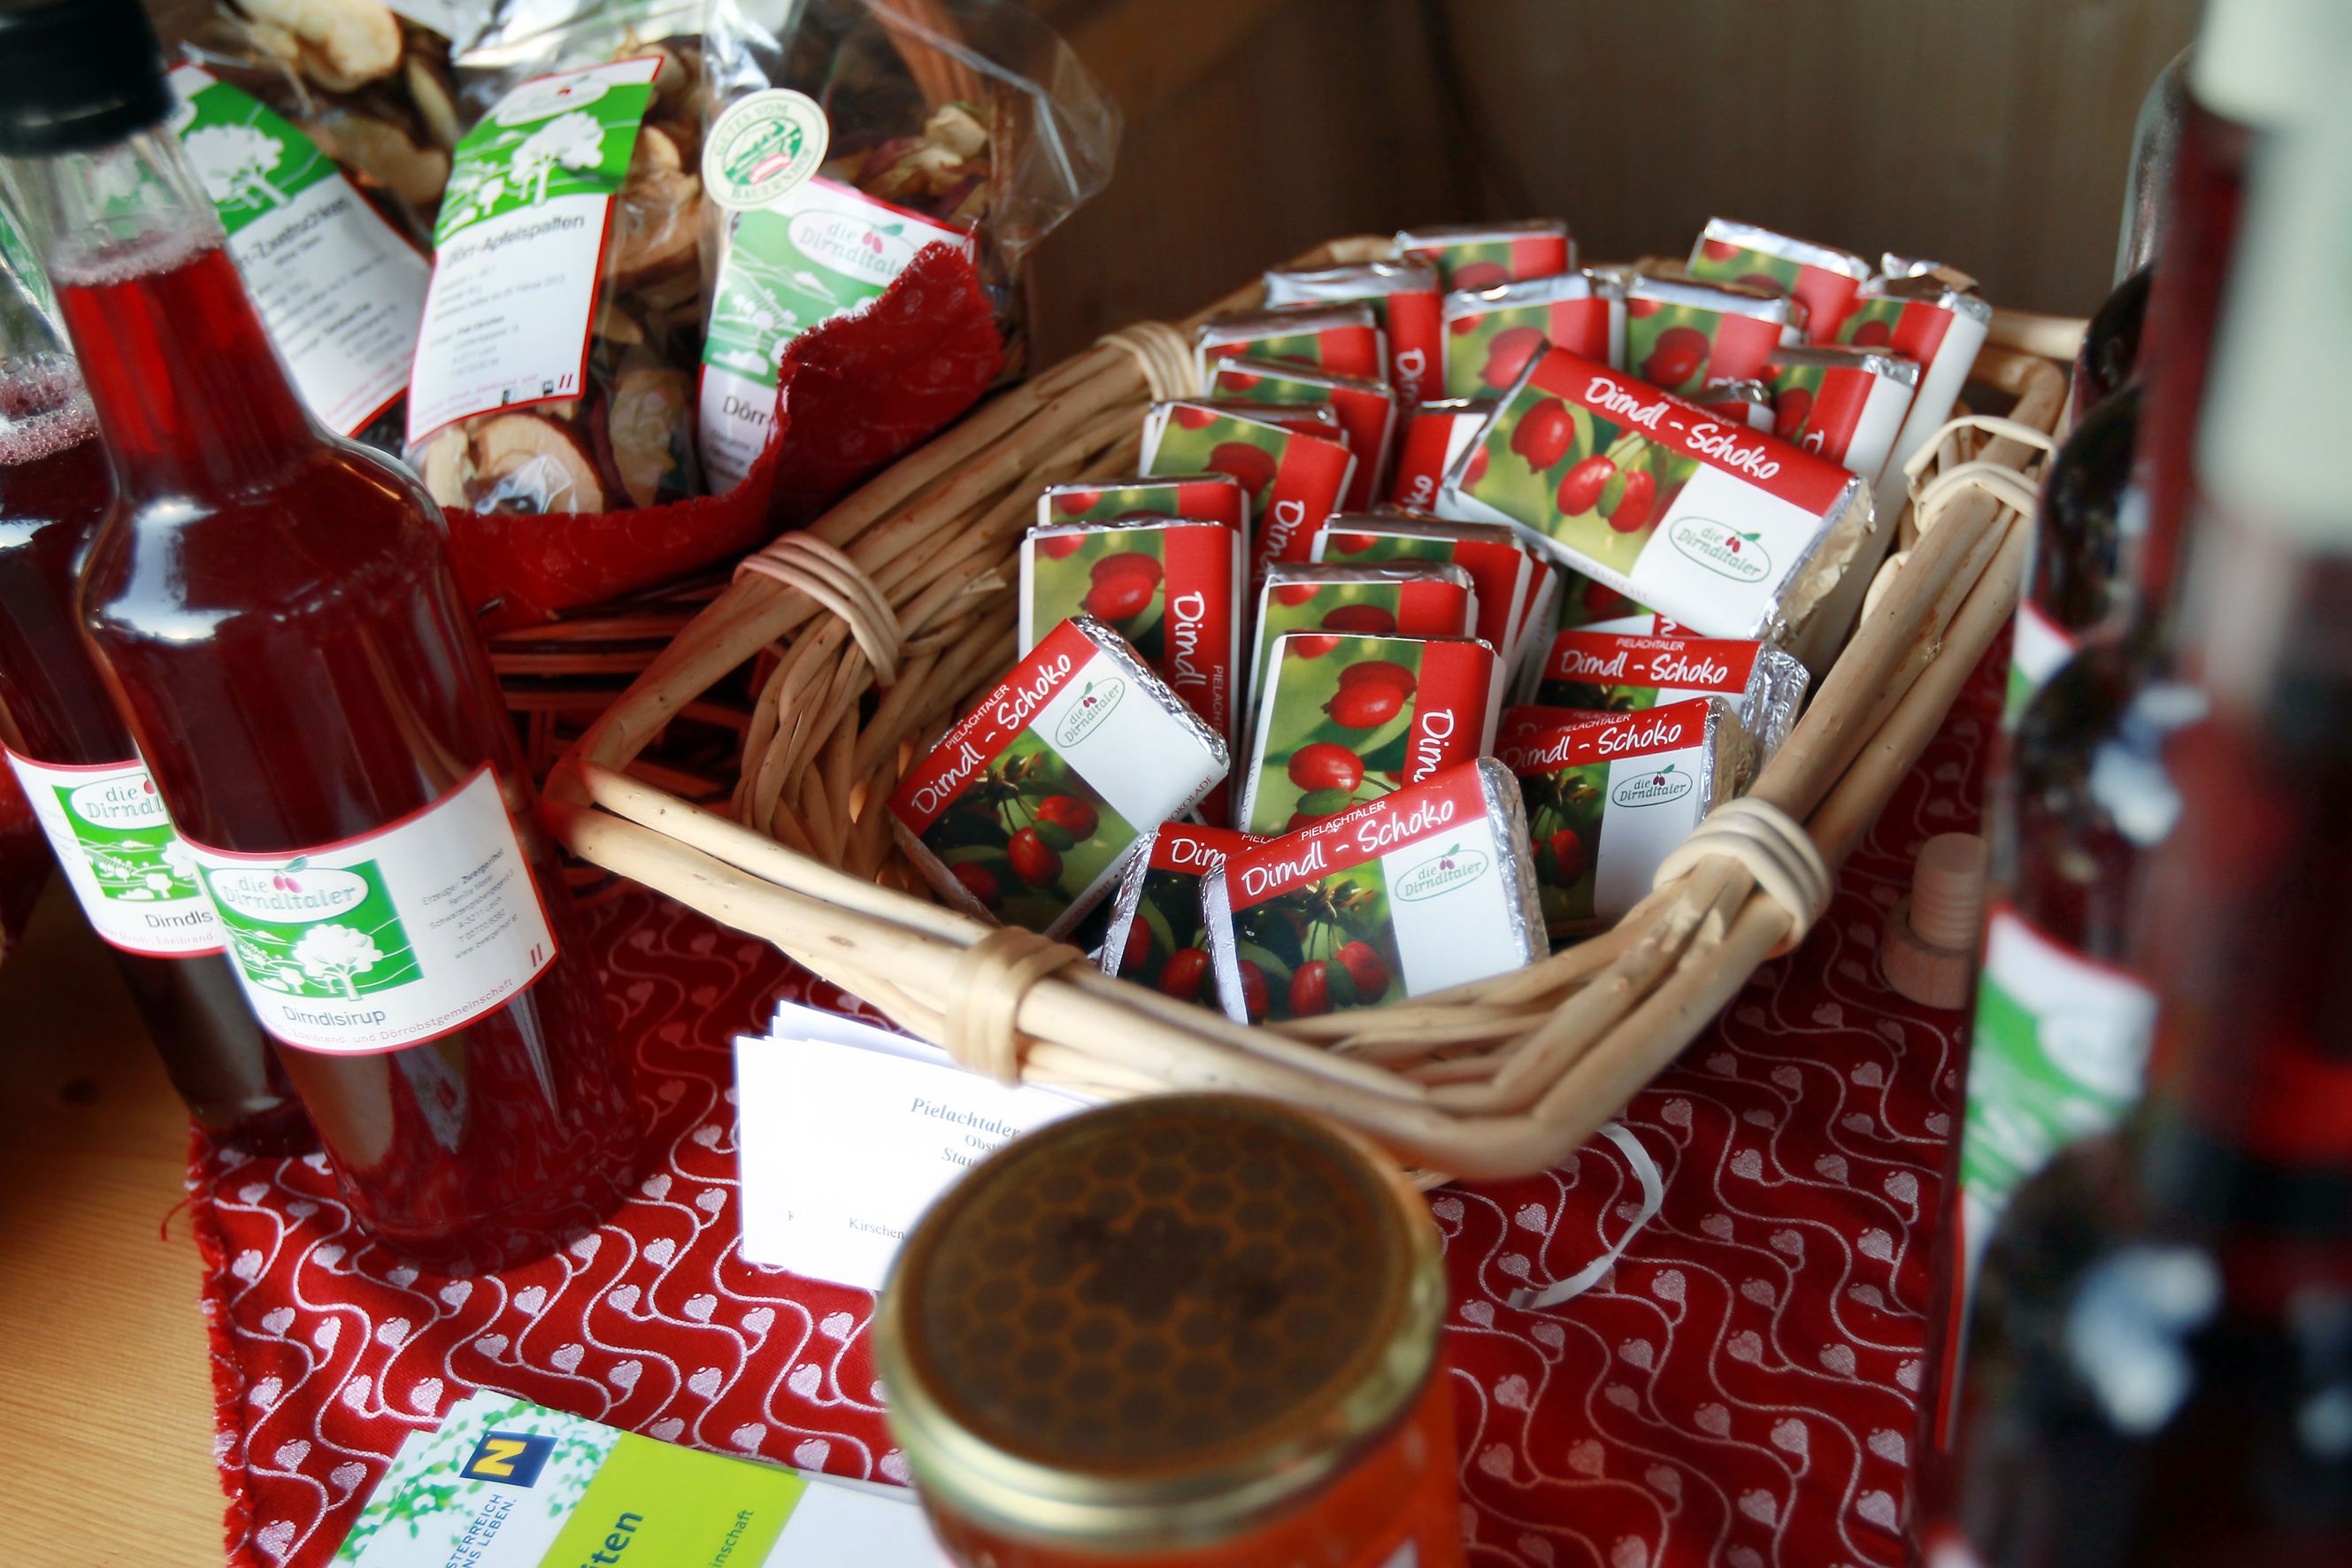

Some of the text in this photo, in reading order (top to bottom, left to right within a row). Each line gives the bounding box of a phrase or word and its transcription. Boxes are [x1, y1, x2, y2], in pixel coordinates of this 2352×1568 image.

[826, 222, 857, 240] die
[799, 225, 902, 278] Dirndltal
[1584, 376, 1671, 431] Dirndl
[1686, 422, 1780, 480] Schoko
[1677, 528, 1762, 576] Dirndltaler
[1700, 527, 1724, 543] die
[1173, 590, 1207, 689] Dirndl
[1615, 637, 1686, 652] PIELACHTALER
[1560, 650, 1628, 679] Dirndl
[1649, 653, 1728, 685] Schoko
[944, 684, 1011, 750] PIELACHTALER
[1064, 684, 1120, 743] Dirndltaler
[1069, 707, 1085, 725] die
[1556, 712, 1632, 734] PIELACHTALER
[911, 741, 986, 814] Dirndl
[997, 653, 1072, 731] Schoko
[1504, 735, 1572, 771] Dirndl
[1597, 719, 1682, 755] Schoko
[105, 787, 138, 802] die
[1618, 782, 1687, 802] Dirndltaler
[1633, 778, 1651, 791] die
[85, 796, 166, 819] Dirndl
[1301, 799, 1387, 842] PIELACHTALER
[1171, 838, 1227, 868] Dirn
[1241, 840, 1327, 897] Dirndl
[1357, 799, 1455, 854] Schoko
[238, 876, 270, 894] die
[1404, 861, 1482, 897] Dirndltaler
[1418, 865, 1437, 880] die
[222, 886, 357, 911] Dirndltaler
[145, 911, 215, 929] Dirndls
[282, 1004, 387, 1027] Dirndlsirup
[353, 1030, 377, 1045] und
[380, 977, 514, 1040] Dörrobstgemeinschaft
[910, 1096, 1022, 1139] Pielachtaler
[447, 1493, 503, 1568] STERREICH
[711, 1508, 755, 1568] inschaft
